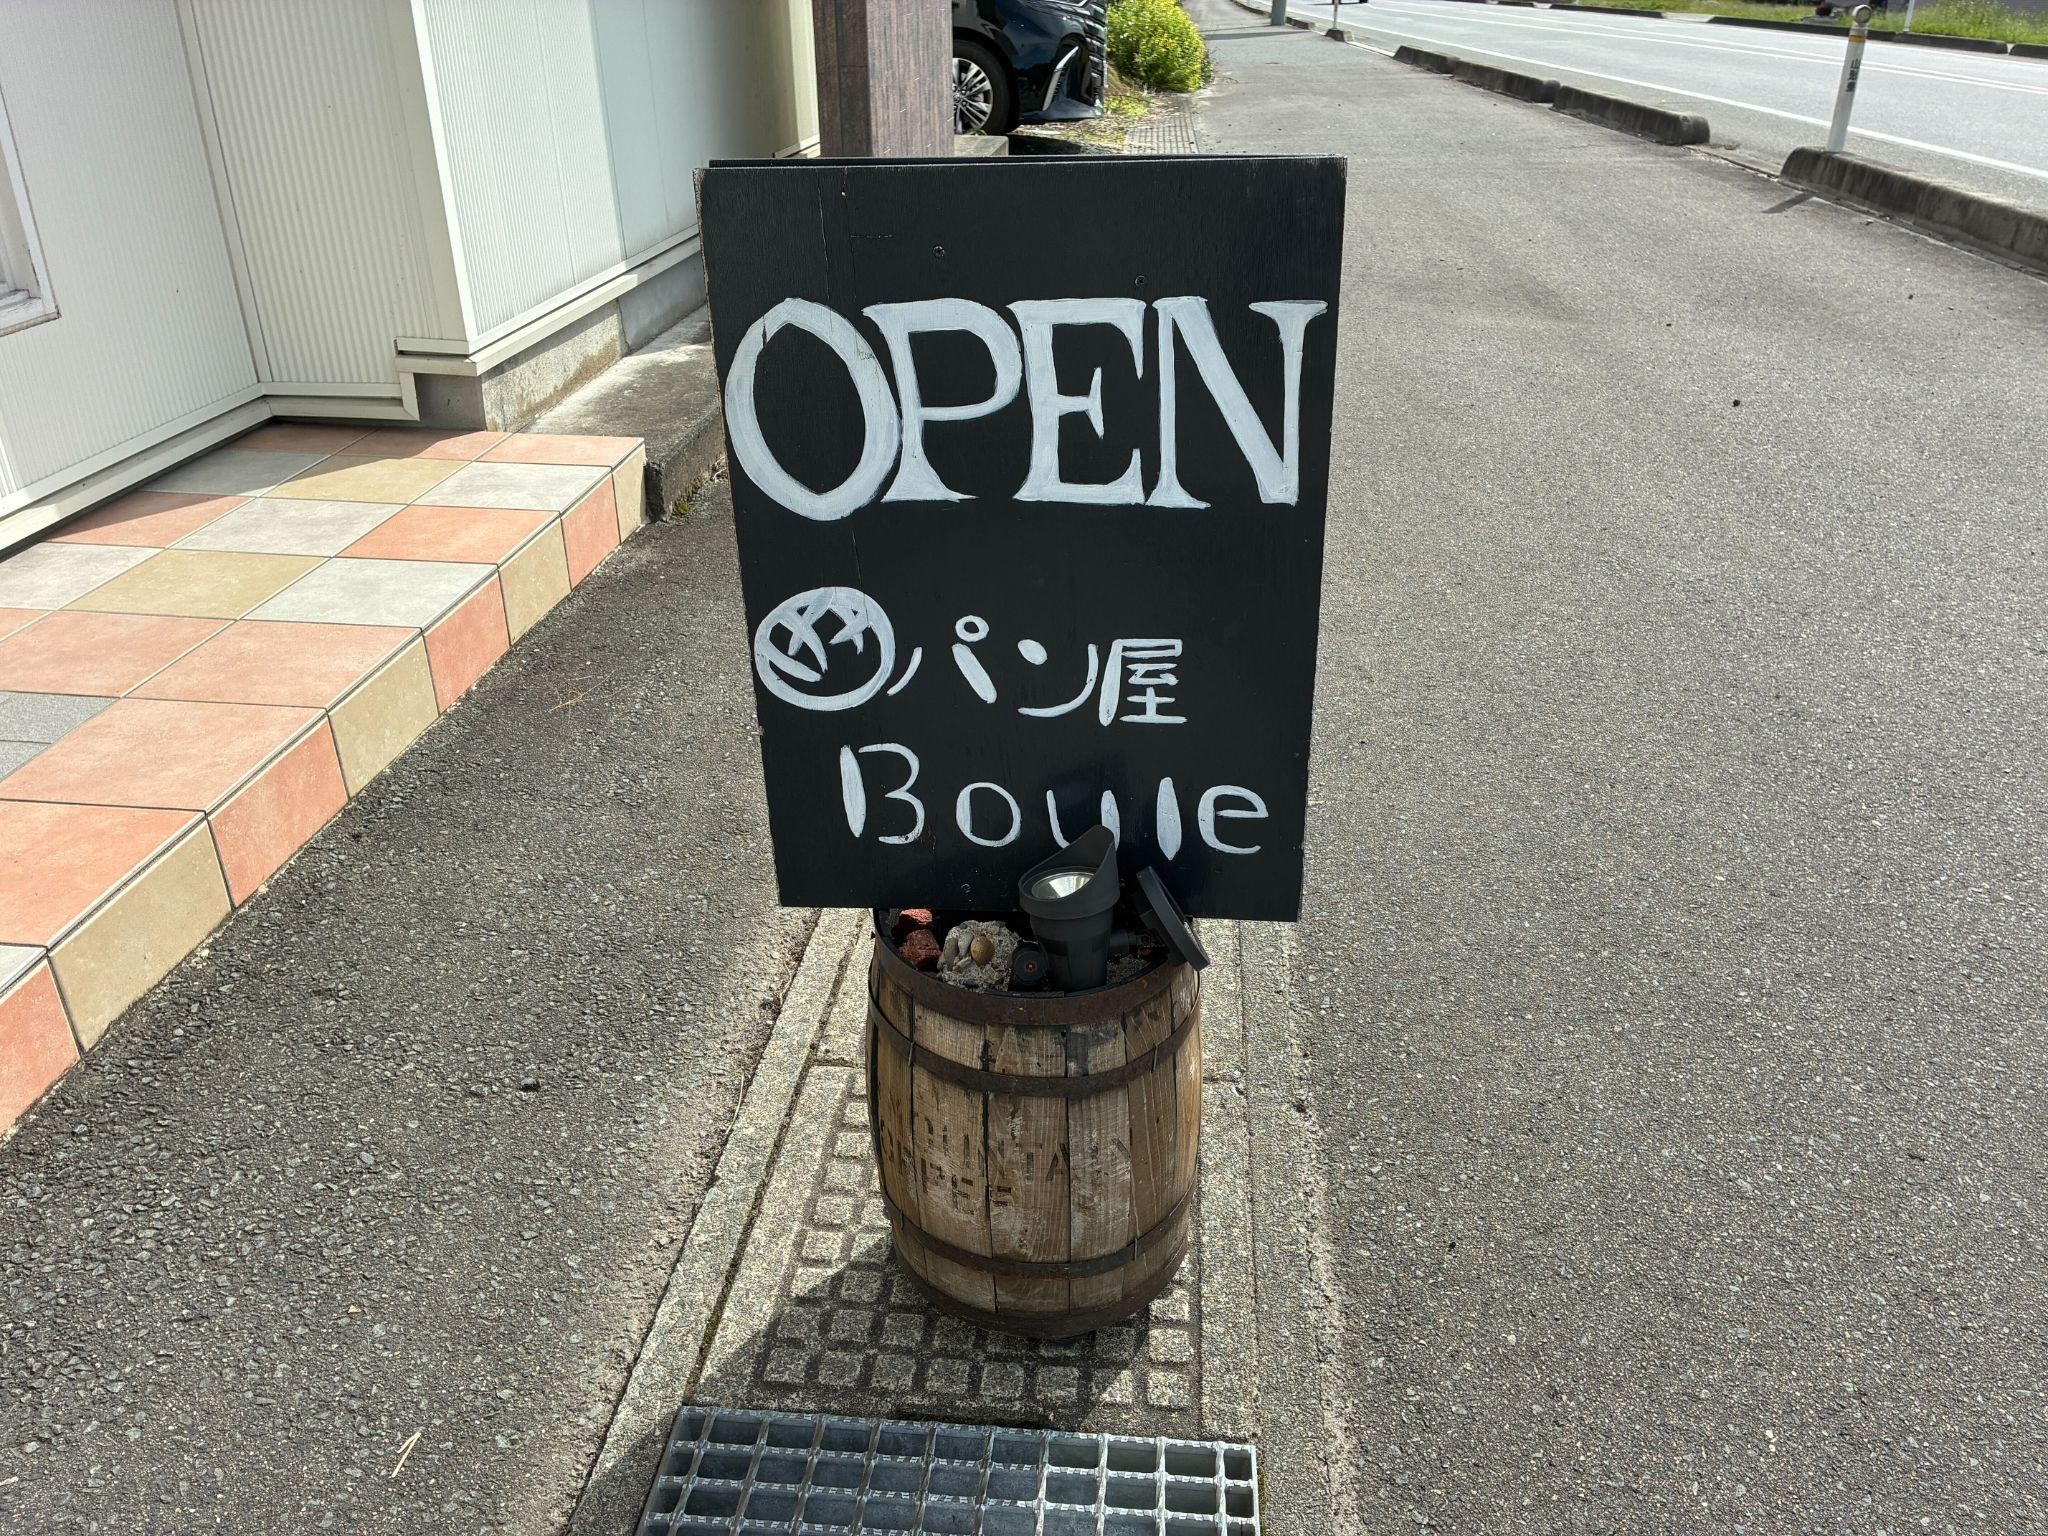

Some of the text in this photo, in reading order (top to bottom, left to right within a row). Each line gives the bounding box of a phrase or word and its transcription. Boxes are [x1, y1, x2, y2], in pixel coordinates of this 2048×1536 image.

[724, 296, 1329, 521] OPEN
[886, 614, 1188, 727] パン屋
[839, 742, 1269, 861] Boule
